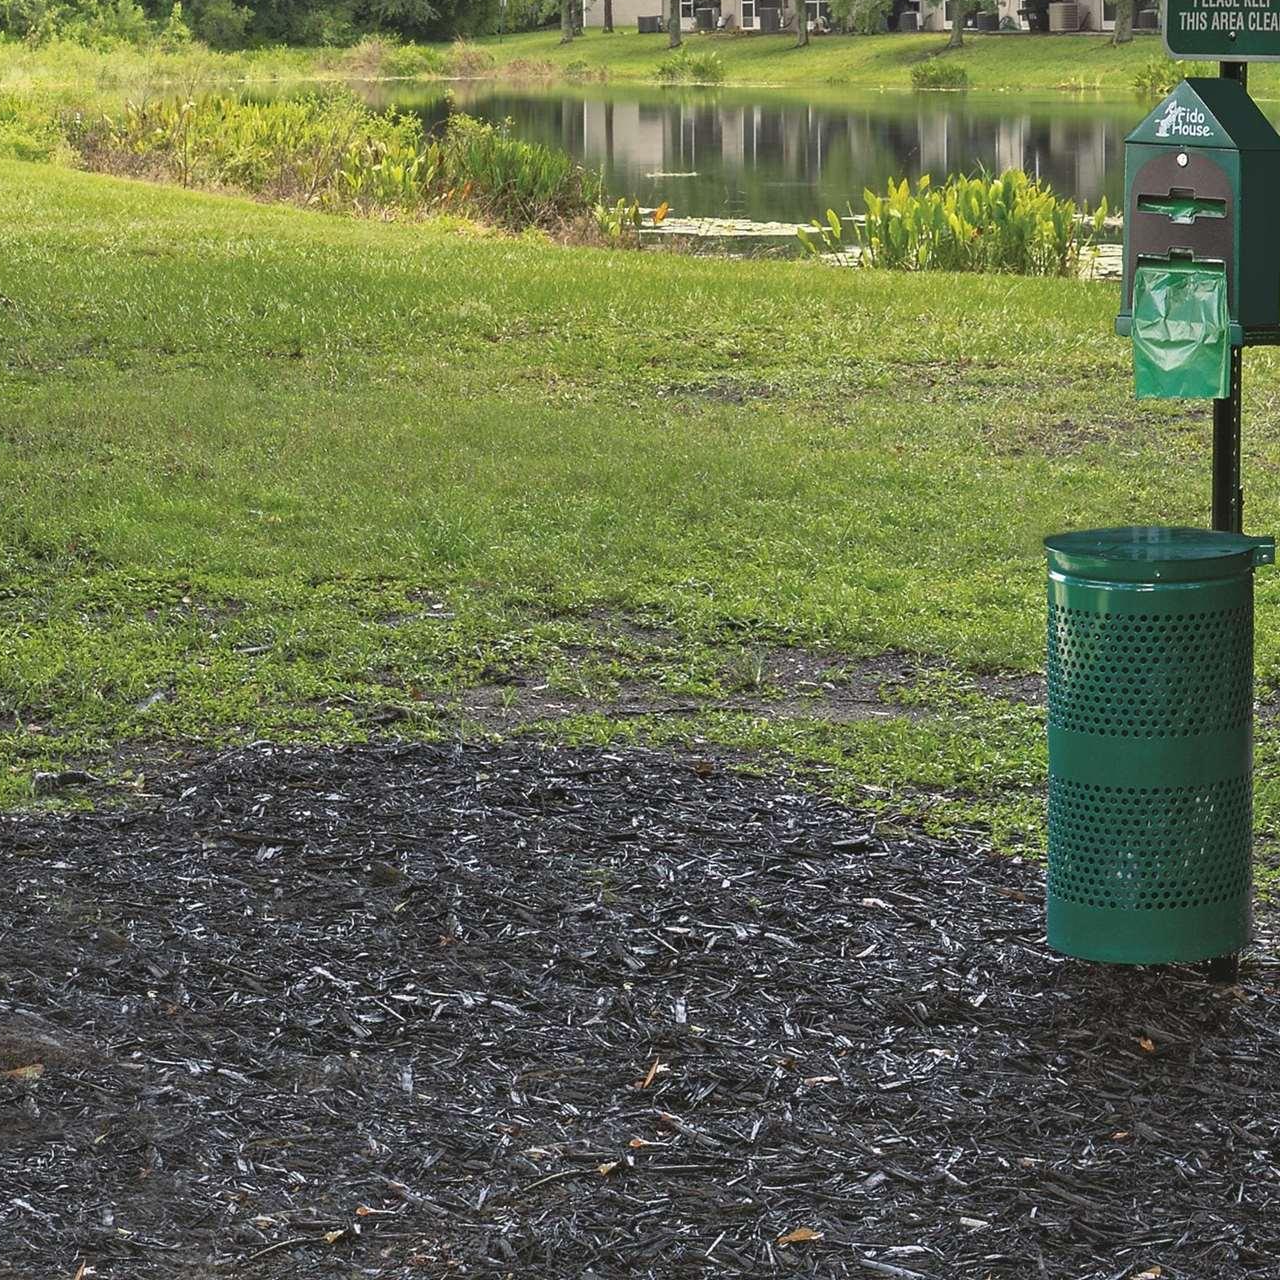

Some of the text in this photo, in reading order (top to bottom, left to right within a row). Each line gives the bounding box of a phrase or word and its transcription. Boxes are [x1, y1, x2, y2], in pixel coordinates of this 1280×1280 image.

[1179, 11, 1207, 31] THIS
[1211, 12, 1245, 31] AREA
[1178, 106, 1205, 123] Fido
